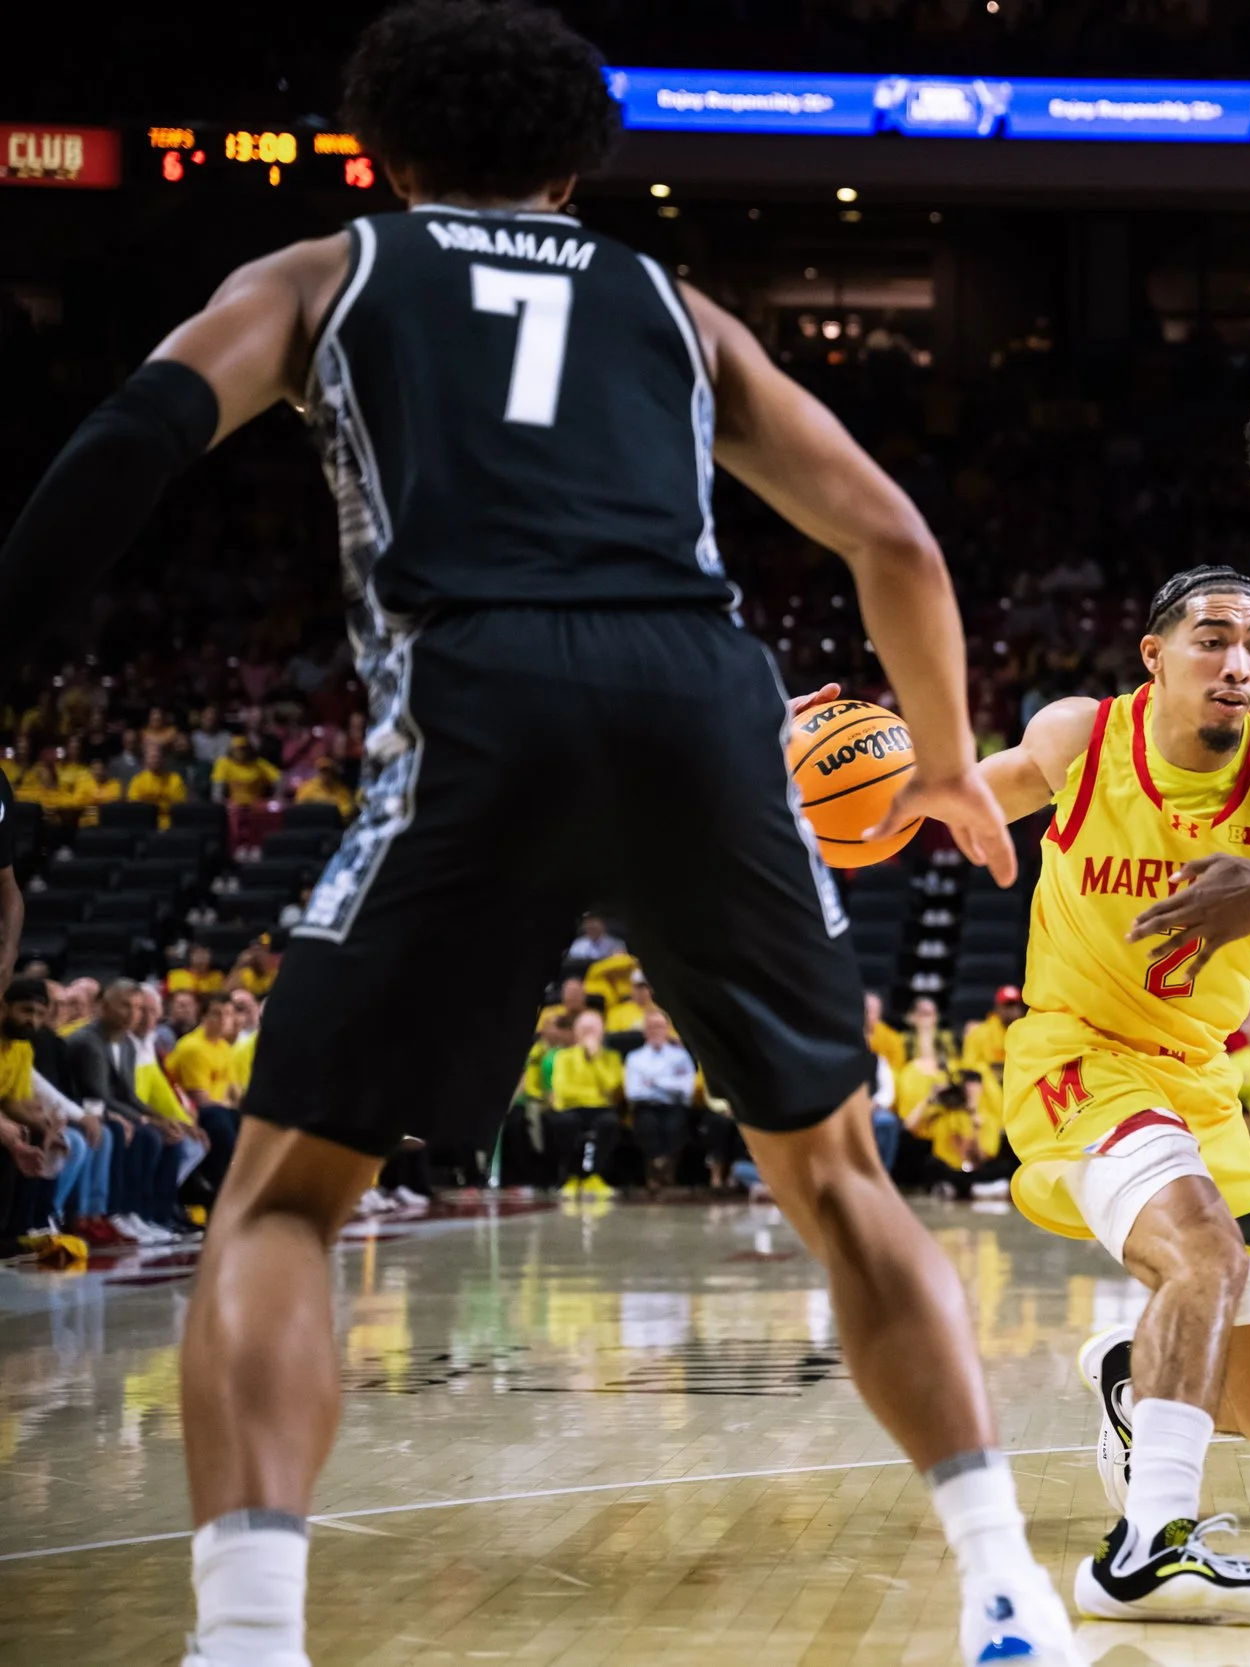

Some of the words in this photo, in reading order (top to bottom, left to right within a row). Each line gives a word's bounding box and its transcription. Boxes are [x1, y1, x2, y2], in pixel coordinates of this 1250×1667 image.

[8, 131, 84, 171] CLUB
[426, 220, 597, 271] ABRAHAM
[471, 263, 573, 428] 7
[801, 702, 872, 734] NCAA
[813, 725, 912, 776] Wilson
[1144, 924, 1203, 1000] 2
[1034, 1056, 1095, 1132] M
